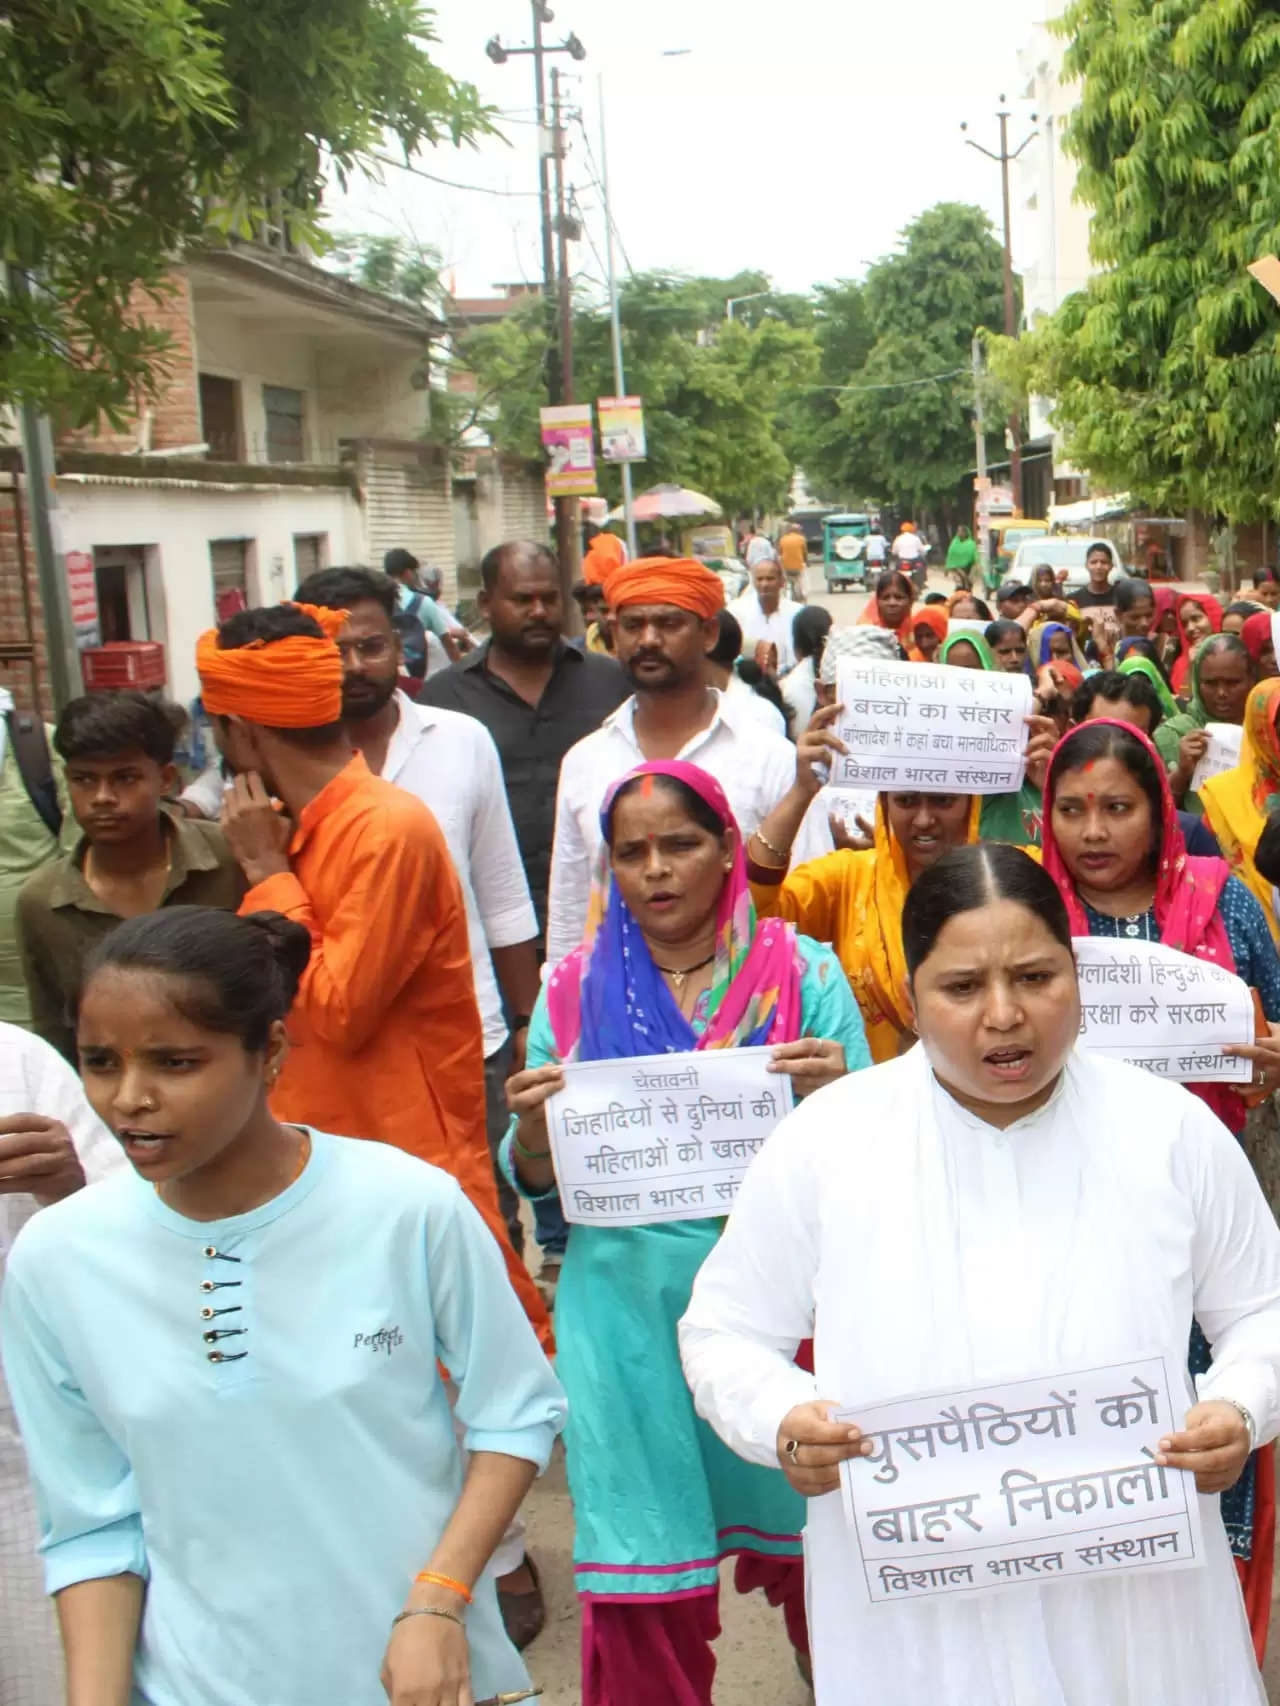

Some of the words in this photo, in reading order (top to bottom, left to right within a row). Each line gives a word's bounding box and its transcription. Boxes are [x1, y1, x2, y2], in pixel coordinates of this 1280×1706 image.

[853, 696, 913, 718] बच्चों
[919, 702, 948, 720] का
[957, 703, 1014, 724] संहार
[843, 758, 898, 780] विशाल
[905, 765, 948, 783] भारत
[955, 766, 1013, 785] संस्थान
[1077, 955, 1142, 984] ग्लादेशी
[1079, 1003, 1122, 1035] ुरक्षा
[1128, 996, 1160, 1025] करे
[1166, 1002, 1228, 1025] सरकार
[632, 1066, 699, 1089] चेतावनी
[1178, 1050, 1237, 1071] संस्थान
[562, 1098, 652, 1137] जिहादियों
[659, 1097, 678, 1125] से
[686, 1094, 744, 1130] दुनियां
[750, 1090, 777, 1119] की
[584, 1137, 670, 1175] महिलाओं
[676, 1134, 703, 1162] को
[573, 1190, 640, 1212] विशाल
[650, 1184, 705, 1208] भारत
[1095, 1375, 1159, 1429] को
[866, 1493, 983, 1544] बाहर
[1000, 1445, 1170, 1526] निकालो
[879, 1564, 974, 1594] विशाल
[986, 1551, 1065, 1578] भारत
[1075, 1530, 1179, 1566] संस्थान
